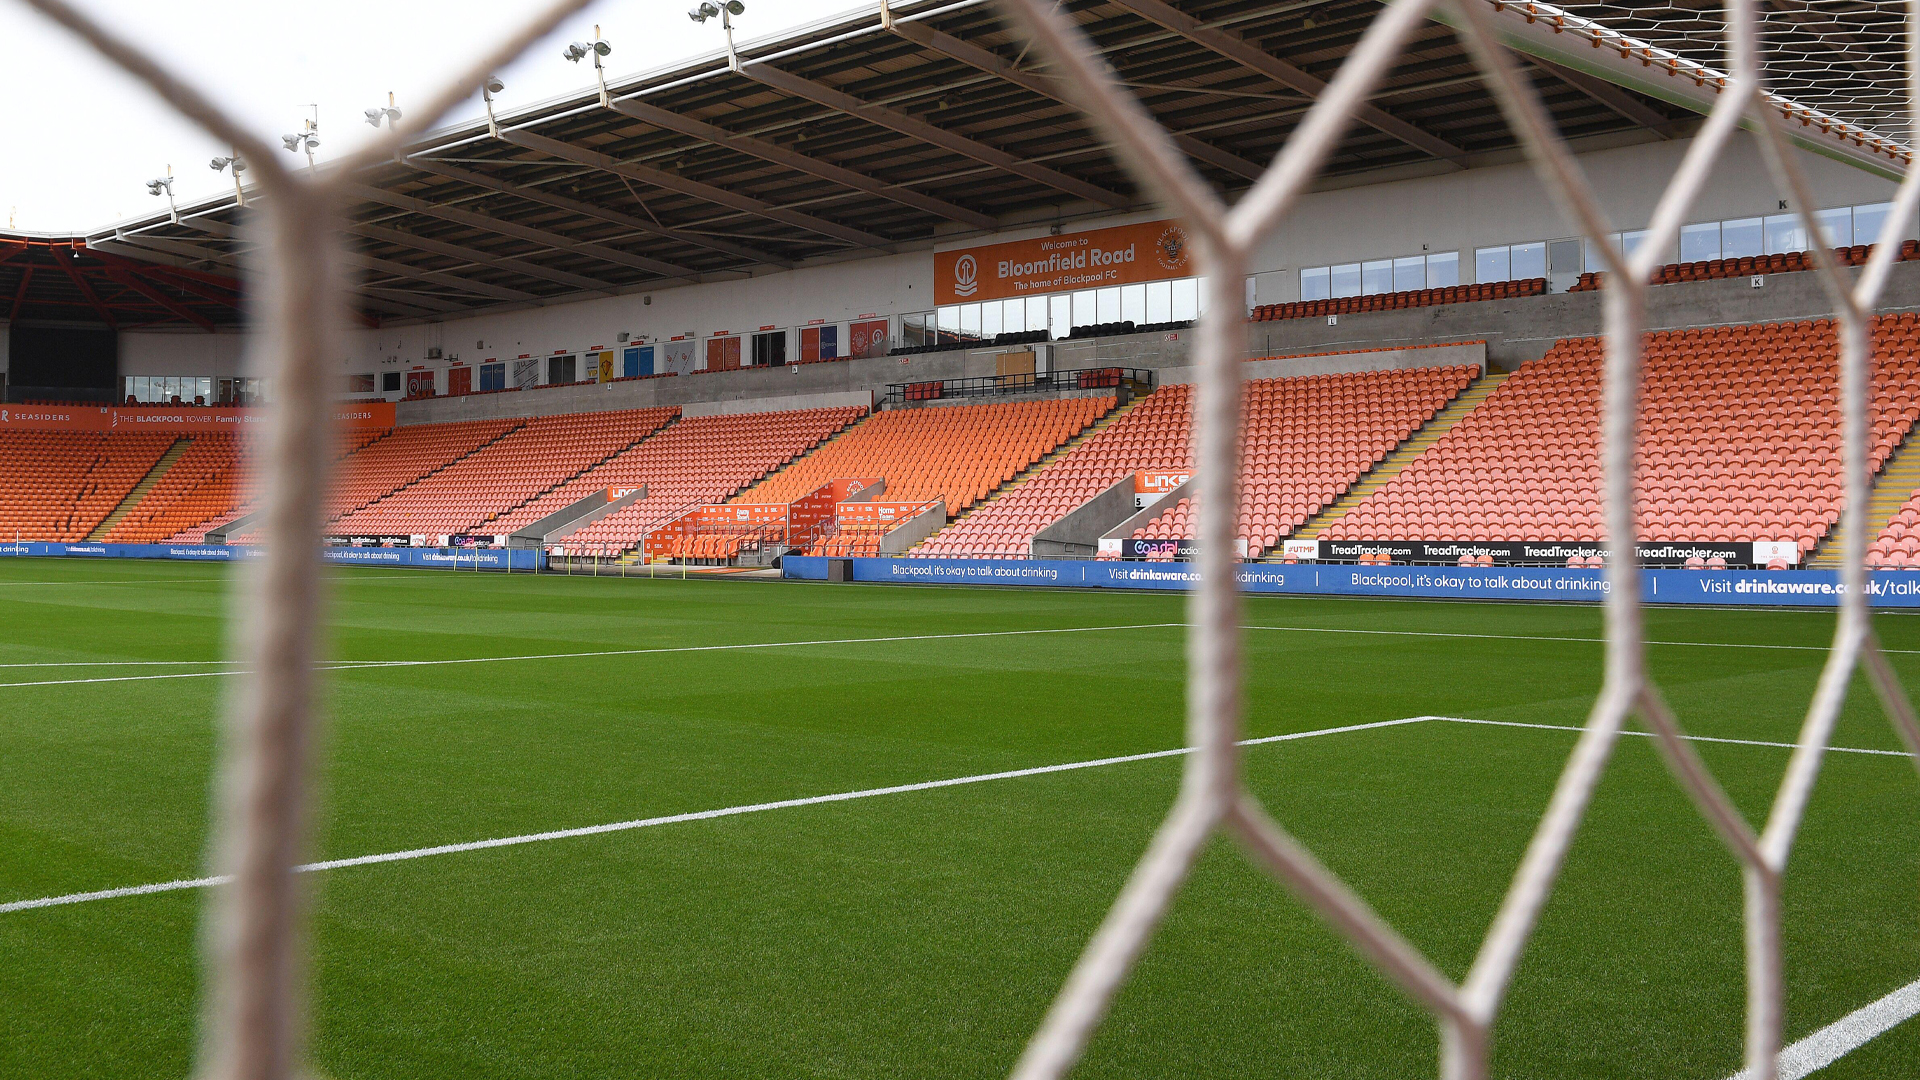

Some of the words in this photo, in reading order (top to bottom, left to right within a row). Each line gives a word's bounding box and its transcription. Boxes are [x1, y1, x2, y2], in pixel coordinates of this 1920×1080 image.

[1779, 200, 1787, 209] K
[1041, 239, 1077, 251] Welcome
[1079, 238, 1088, 246] to
[998, 250, 1086, 278] Bloomfield
[1090, 243, 1135, 267] Road
[1014, 281, 1028, 291] The
[1029, 280, 1051, 289] home
[1053, 276, 1062, 286] of
[1063, 271, 1103, 285] Blackpool
[1105, 270, 1117, 280] FC
[15, 413, 70, 421] SEASIDERS
[136, 415, 184, 423] BLACKPOOL
[215, 415, 242, 424] Family
[1135, 497, 1141, 506] 5
[878, 506, 895, 514] Home
[1134, 540, 1178, 555] Coastal
[1330, 544, 1412, 555] TreadTracker.com
[1423, 544, 1510, 556] TreadTracker.com
[1634, 546, 1736, 558] TreadTracker.com
[892, 564, 933, 577] Blackpool,
[945, 565, 965, 578] okay
[967, 566, 975, 576] to
[977, 566, 992, 576] talk
[994, 566, 1020, 577] about
[1021, 566, 1058, 580] drinking
[1109, 568, 1129, 580] Visit
[1351, 573, 1414, 588] Blackpool,
[1434, 574, 1465, 590] okay
[1468, 576, 1482, 588] to
[1484, 575, 1509, 588] talk
[1511, 576, 1552, 590] about
[1555, 576, 1611, 593] drinking
[1700, 578, 1731, 593] Visit
